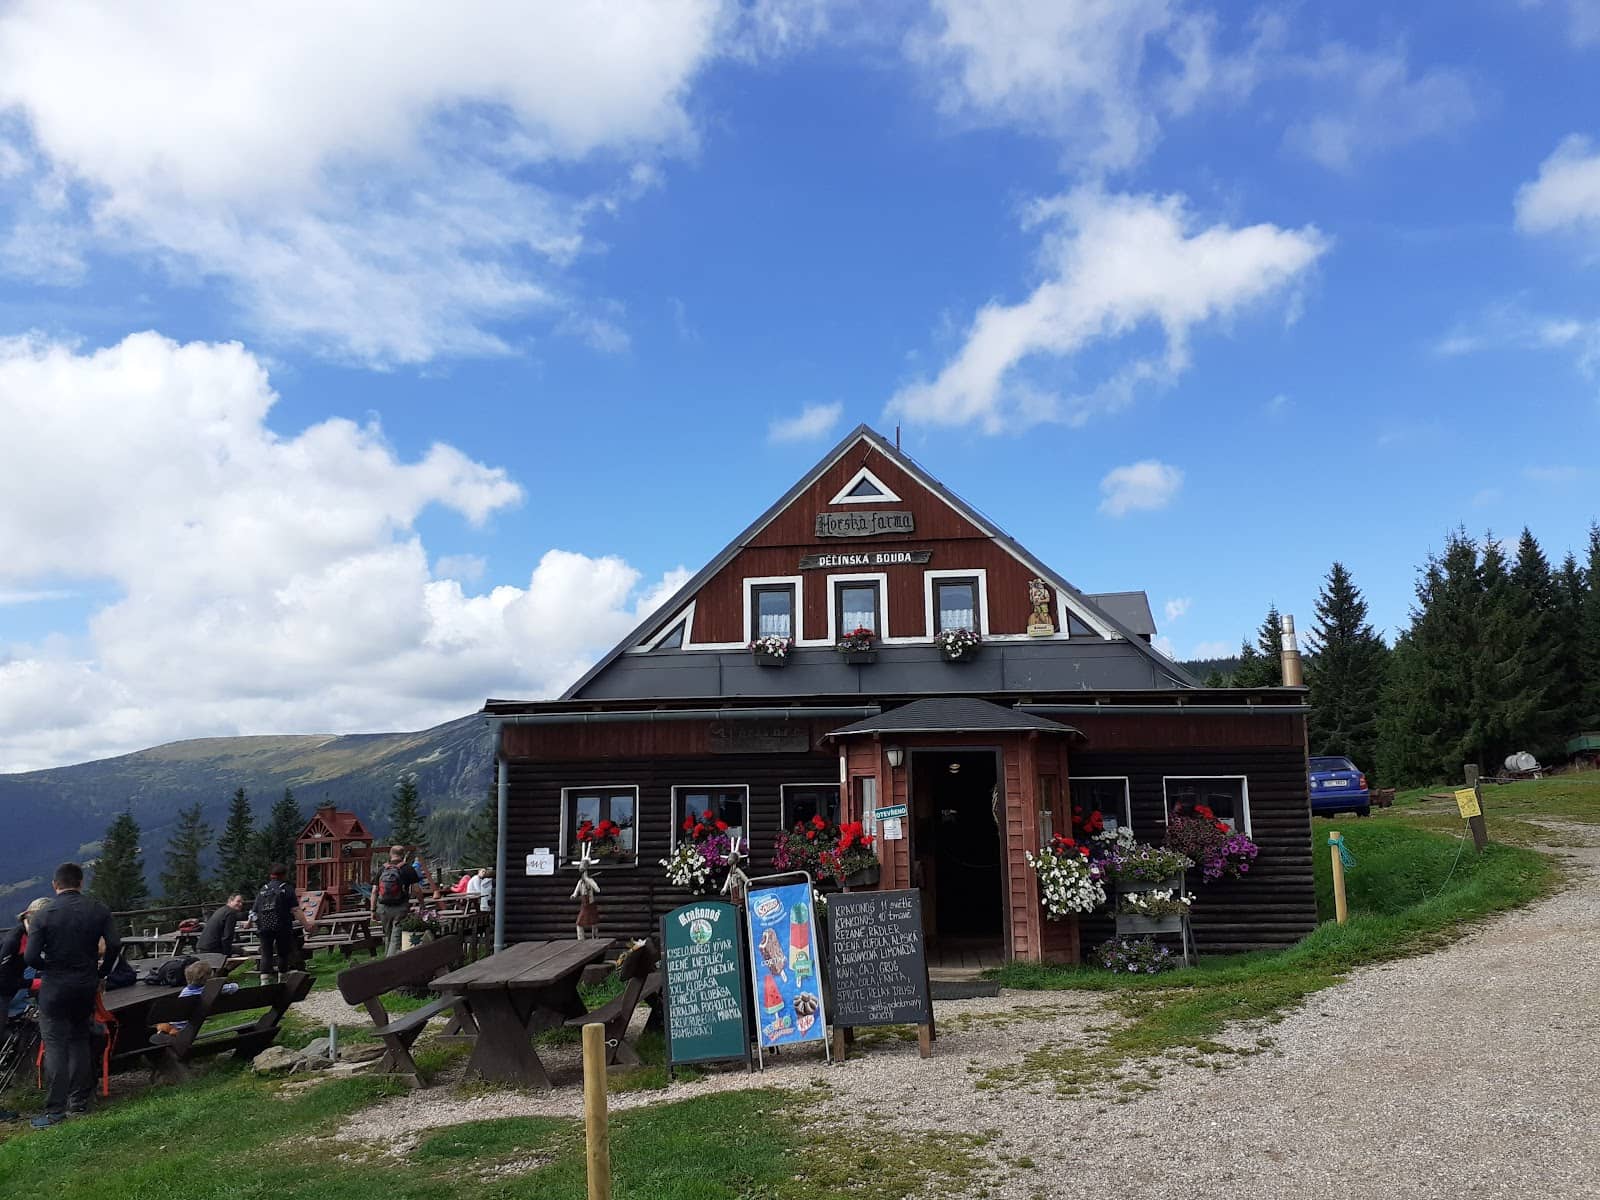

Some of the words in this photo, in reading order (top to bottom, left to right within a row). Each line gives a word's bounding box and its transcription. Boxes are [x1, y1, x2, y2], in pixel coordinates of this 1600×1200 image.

[869, 512, 912, 533] farma
[876, 552, 912, 564] BOUDA
[678, 907, 722, 926] Krakonoš
[670, 984, 684, 994] XXL
